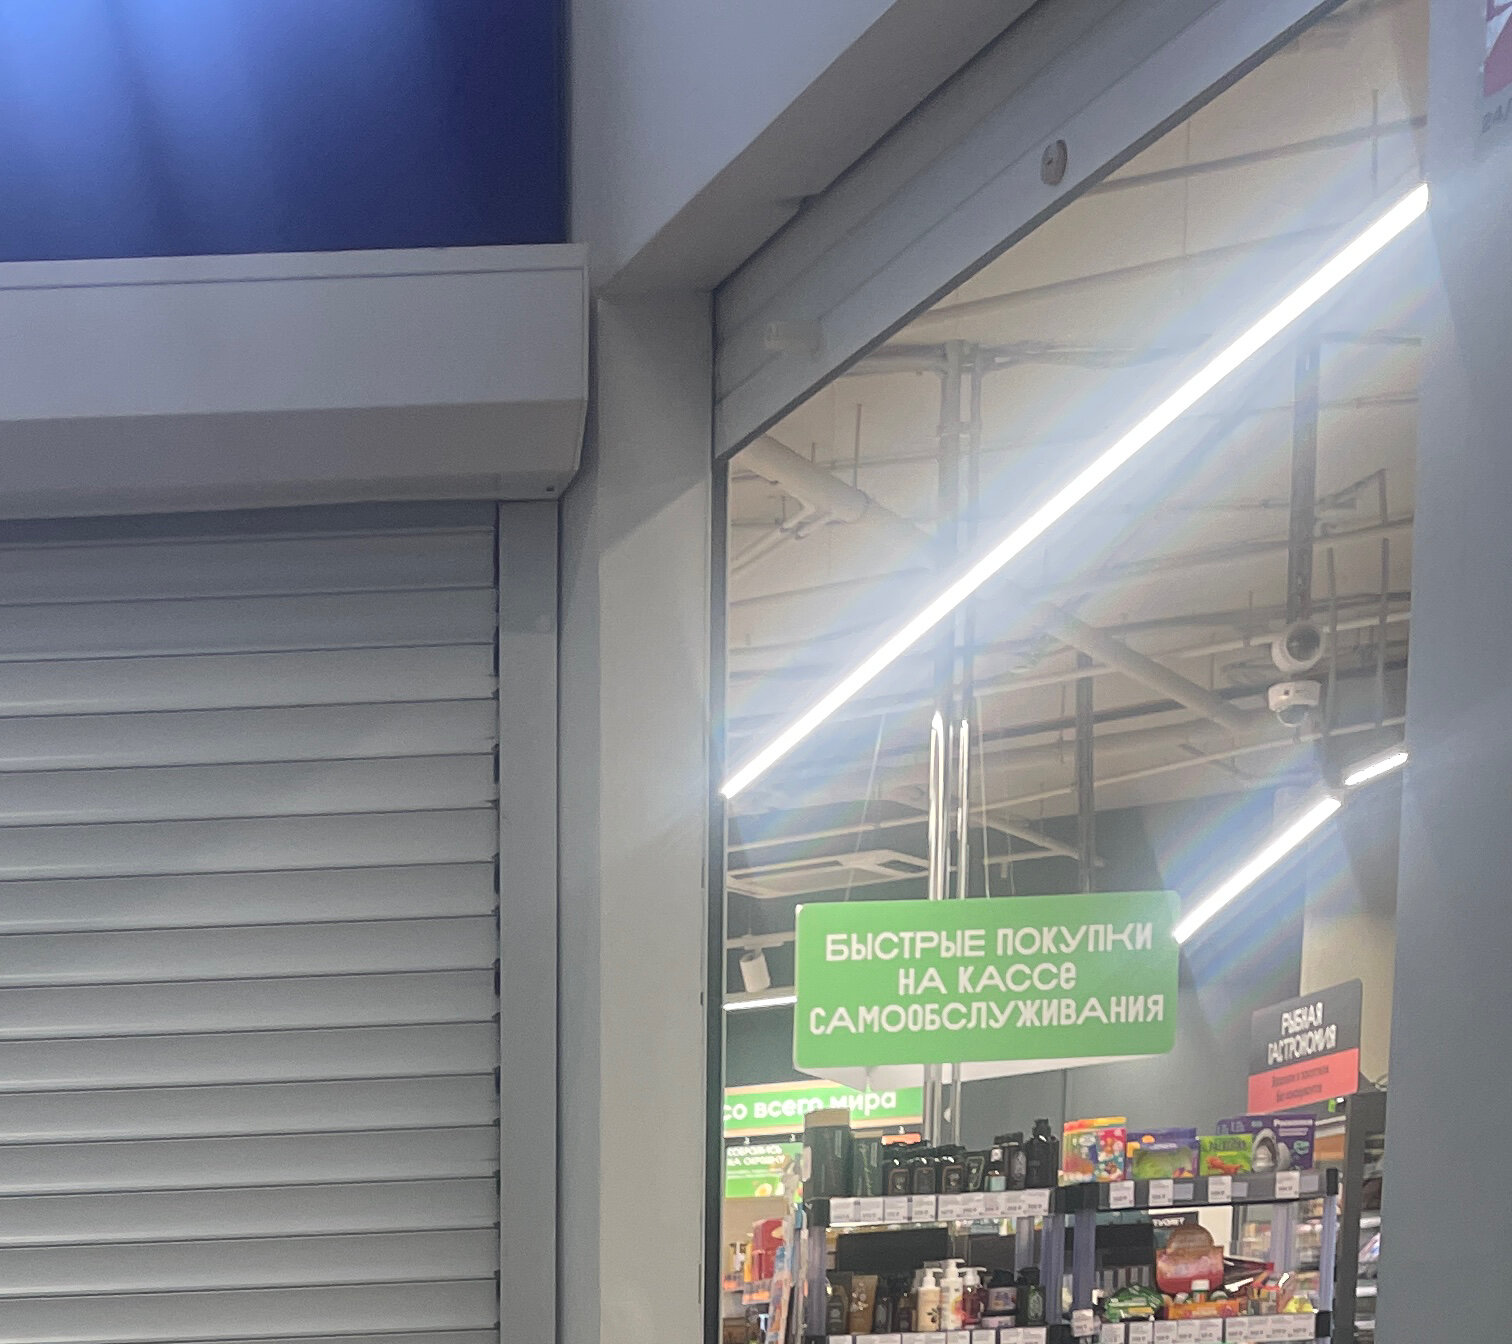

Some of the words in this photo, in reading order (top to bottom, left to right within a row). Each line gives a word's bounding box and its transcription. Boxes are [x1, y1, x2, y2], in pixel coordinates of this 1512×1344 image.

[825, 929, 986, 962] БЫСТРЫЕ
[996, 922, 1153, 956] ПОКУПКИ
[898, 967, 947, 996] НА
[809, 994, 1164, 1035] САМООБСЛУЖИВАНИЯ
